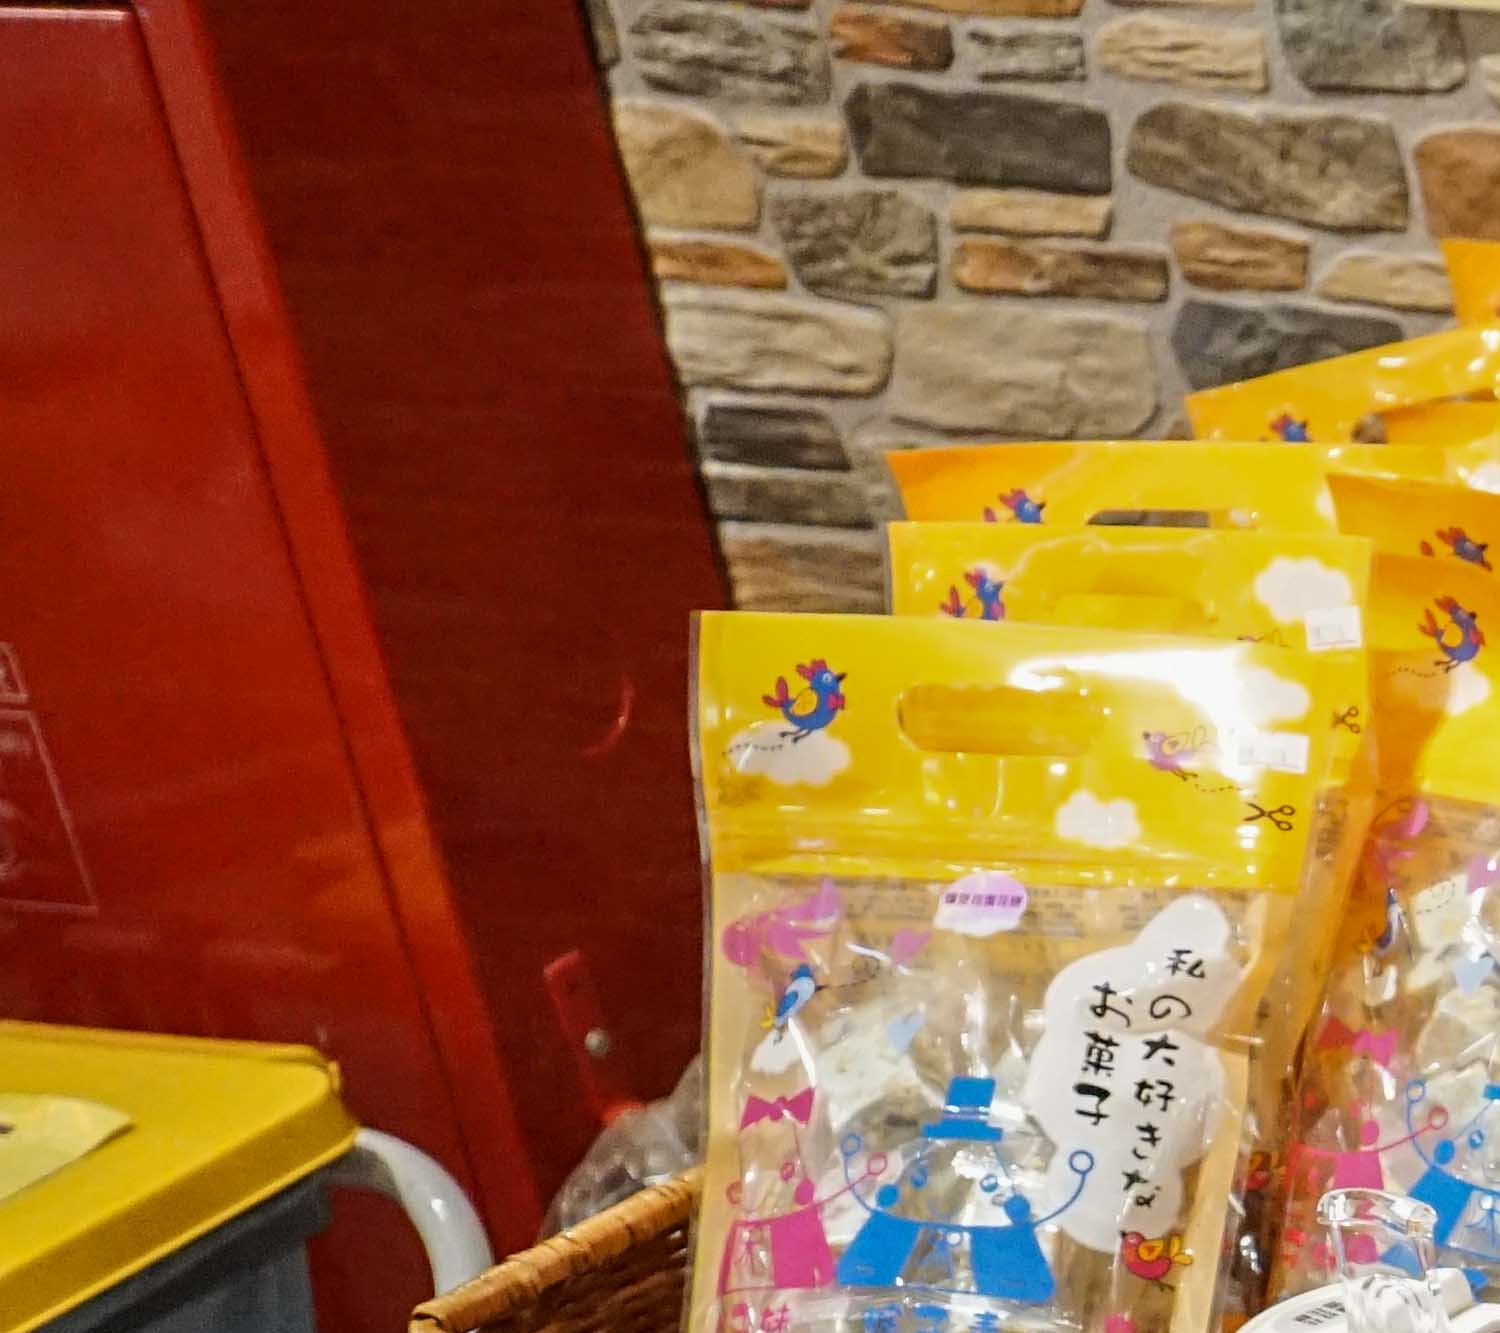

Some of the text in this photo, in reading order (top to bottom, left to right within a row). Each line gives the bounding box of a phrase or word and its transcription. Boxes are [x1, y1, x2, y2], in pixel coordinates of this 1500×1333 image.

[1073, 981, 1133, 1126] お菓子
[1121, 948, 1206, 1208] 私の大好きな
